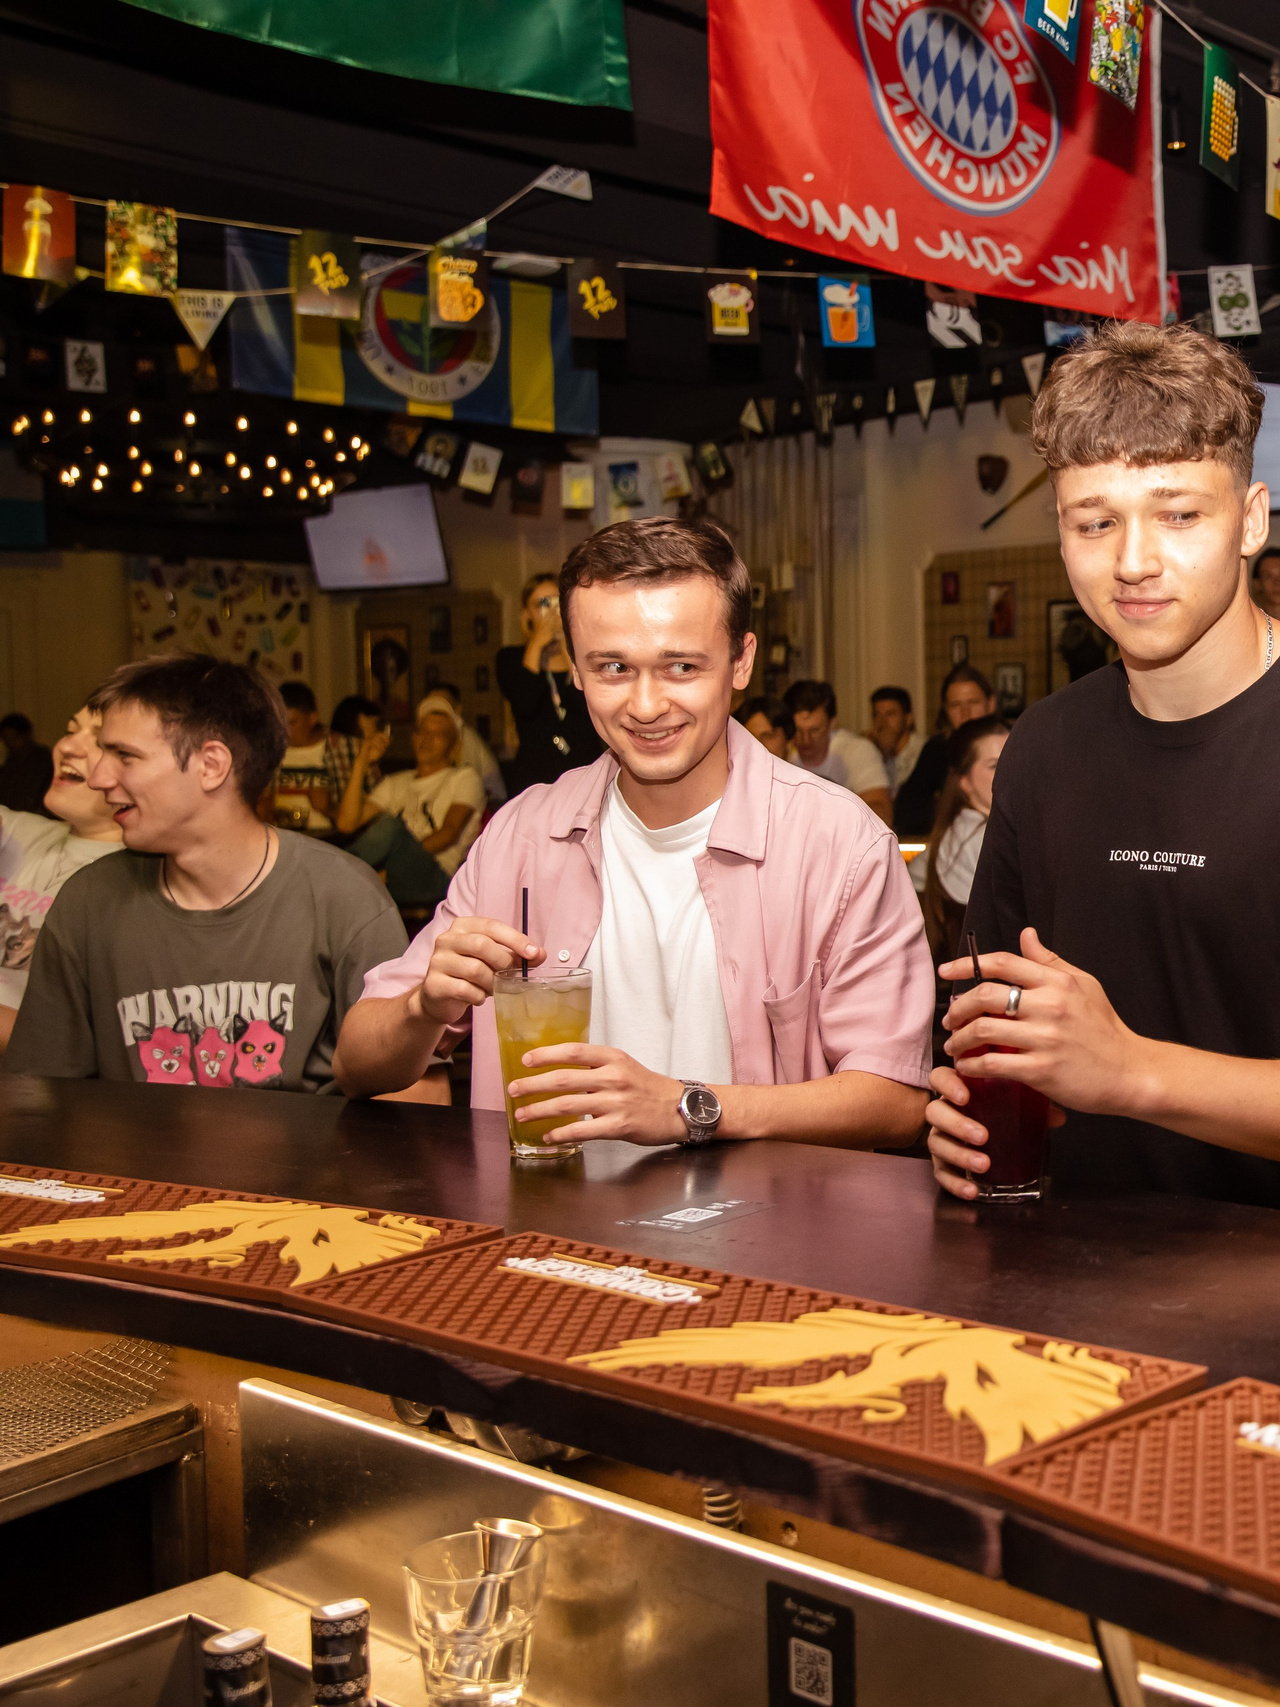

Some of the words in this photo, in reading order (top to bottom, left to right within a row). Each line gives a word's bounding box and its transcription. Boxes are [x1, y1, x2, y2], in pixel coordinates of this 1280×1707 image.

[1037, 17, 1056, 39] BEER
[1054, 31, 1070, 52] KING
[180, 295, 207, 308] THIS
[211, 296, 224, 308] IS
[1109, 850, 1149, 862] ICONO
[1153, 851, 1206, 868] COUTURE
[1140, 863, 1158, 871] PARIS
[1162, 865, 1178, 873] TOKYO
[116, 980, 296, 1047] WARNING
